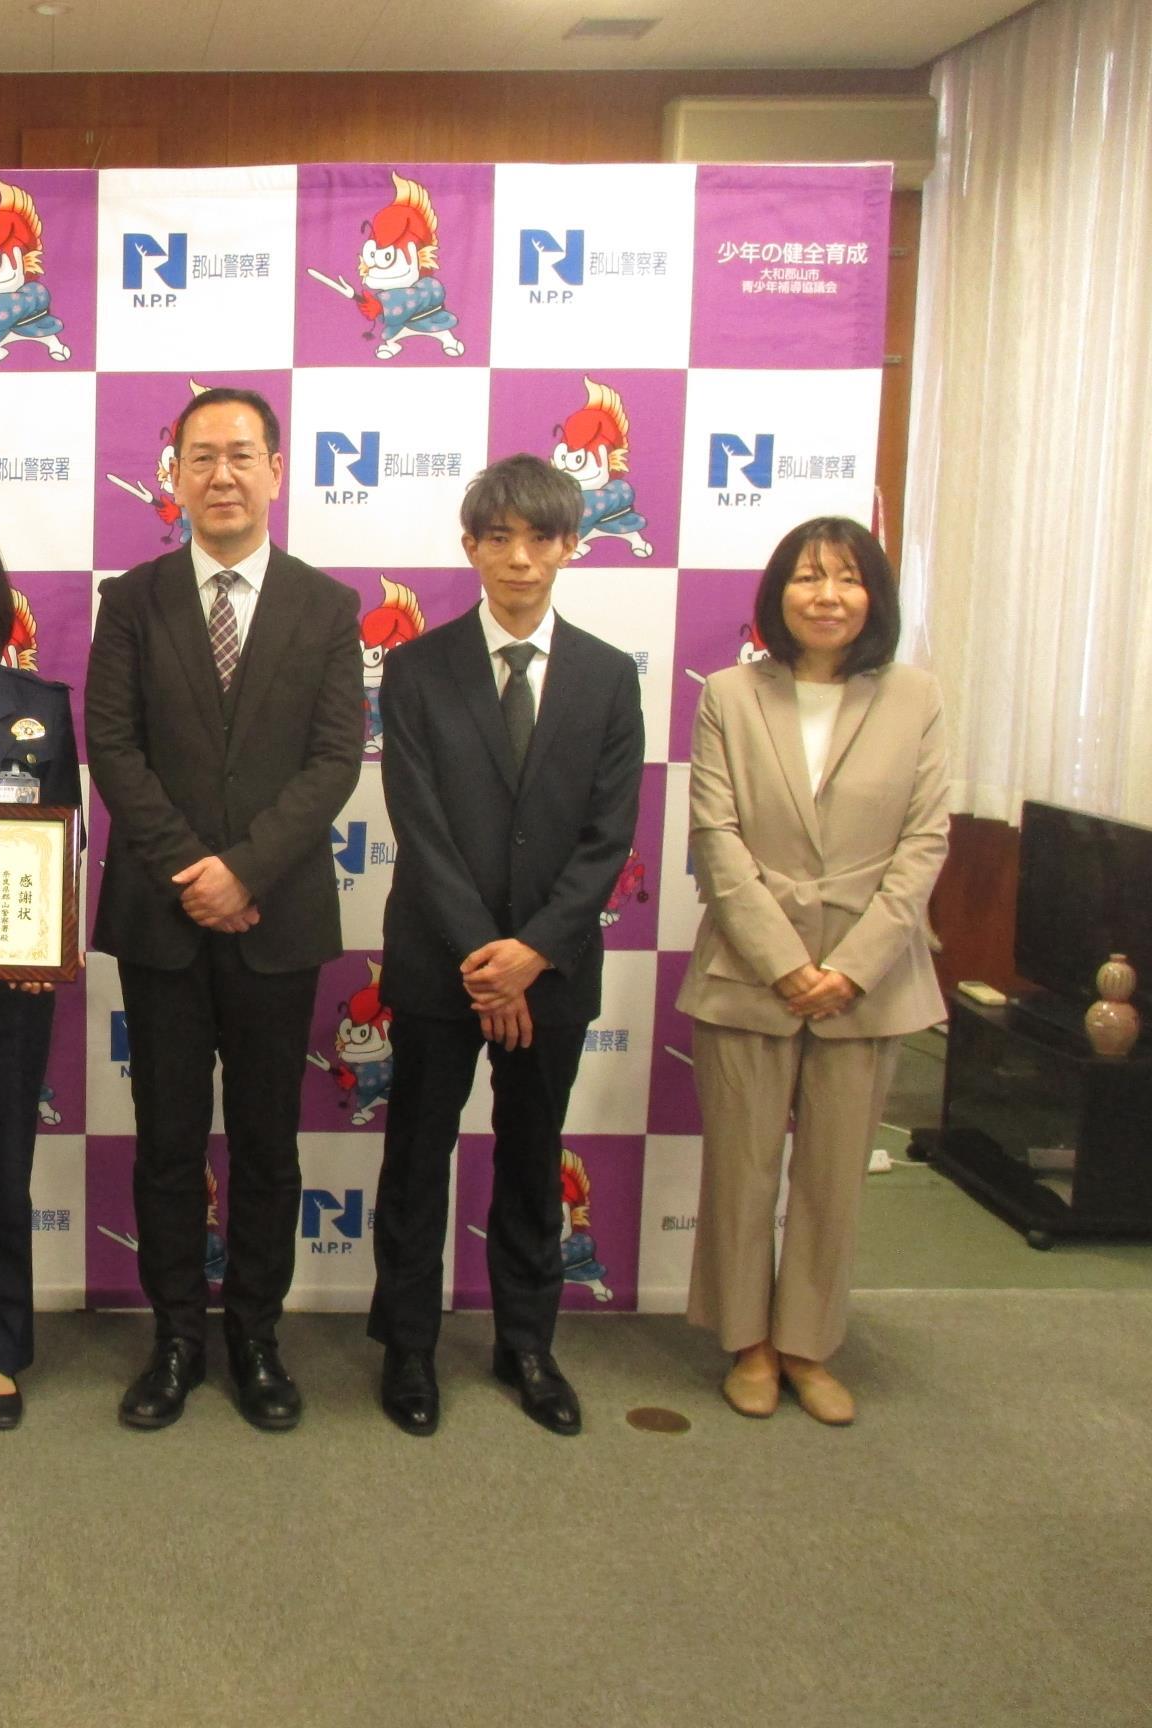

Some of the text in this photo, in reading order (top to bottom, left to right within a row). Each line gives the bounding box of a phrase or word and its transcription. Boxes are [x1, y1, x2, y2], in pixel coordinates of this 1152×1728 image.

[718, 241, 869, 265] 少年の健全育成
[192, 253, 270, 279] 郡山警察署
[589, 251, 668, 276] 郡山警察署
[760, 268, 820, 281] 大和郡山市
[133, 293, 177, 308] N.P.P.
[529, 290, 573, 304] N.P.P.
[384, 453, 462, 477] 郡山警察署
[777, 455, 856, 479] 郡山警察署
[325, 491, 368, 505] N.P.P.
[717, 493, 762, 506] N.P.P.
[16, 873, 32, 921] 感謝状
[311, 1241, 352, 1254] N.P.P.
